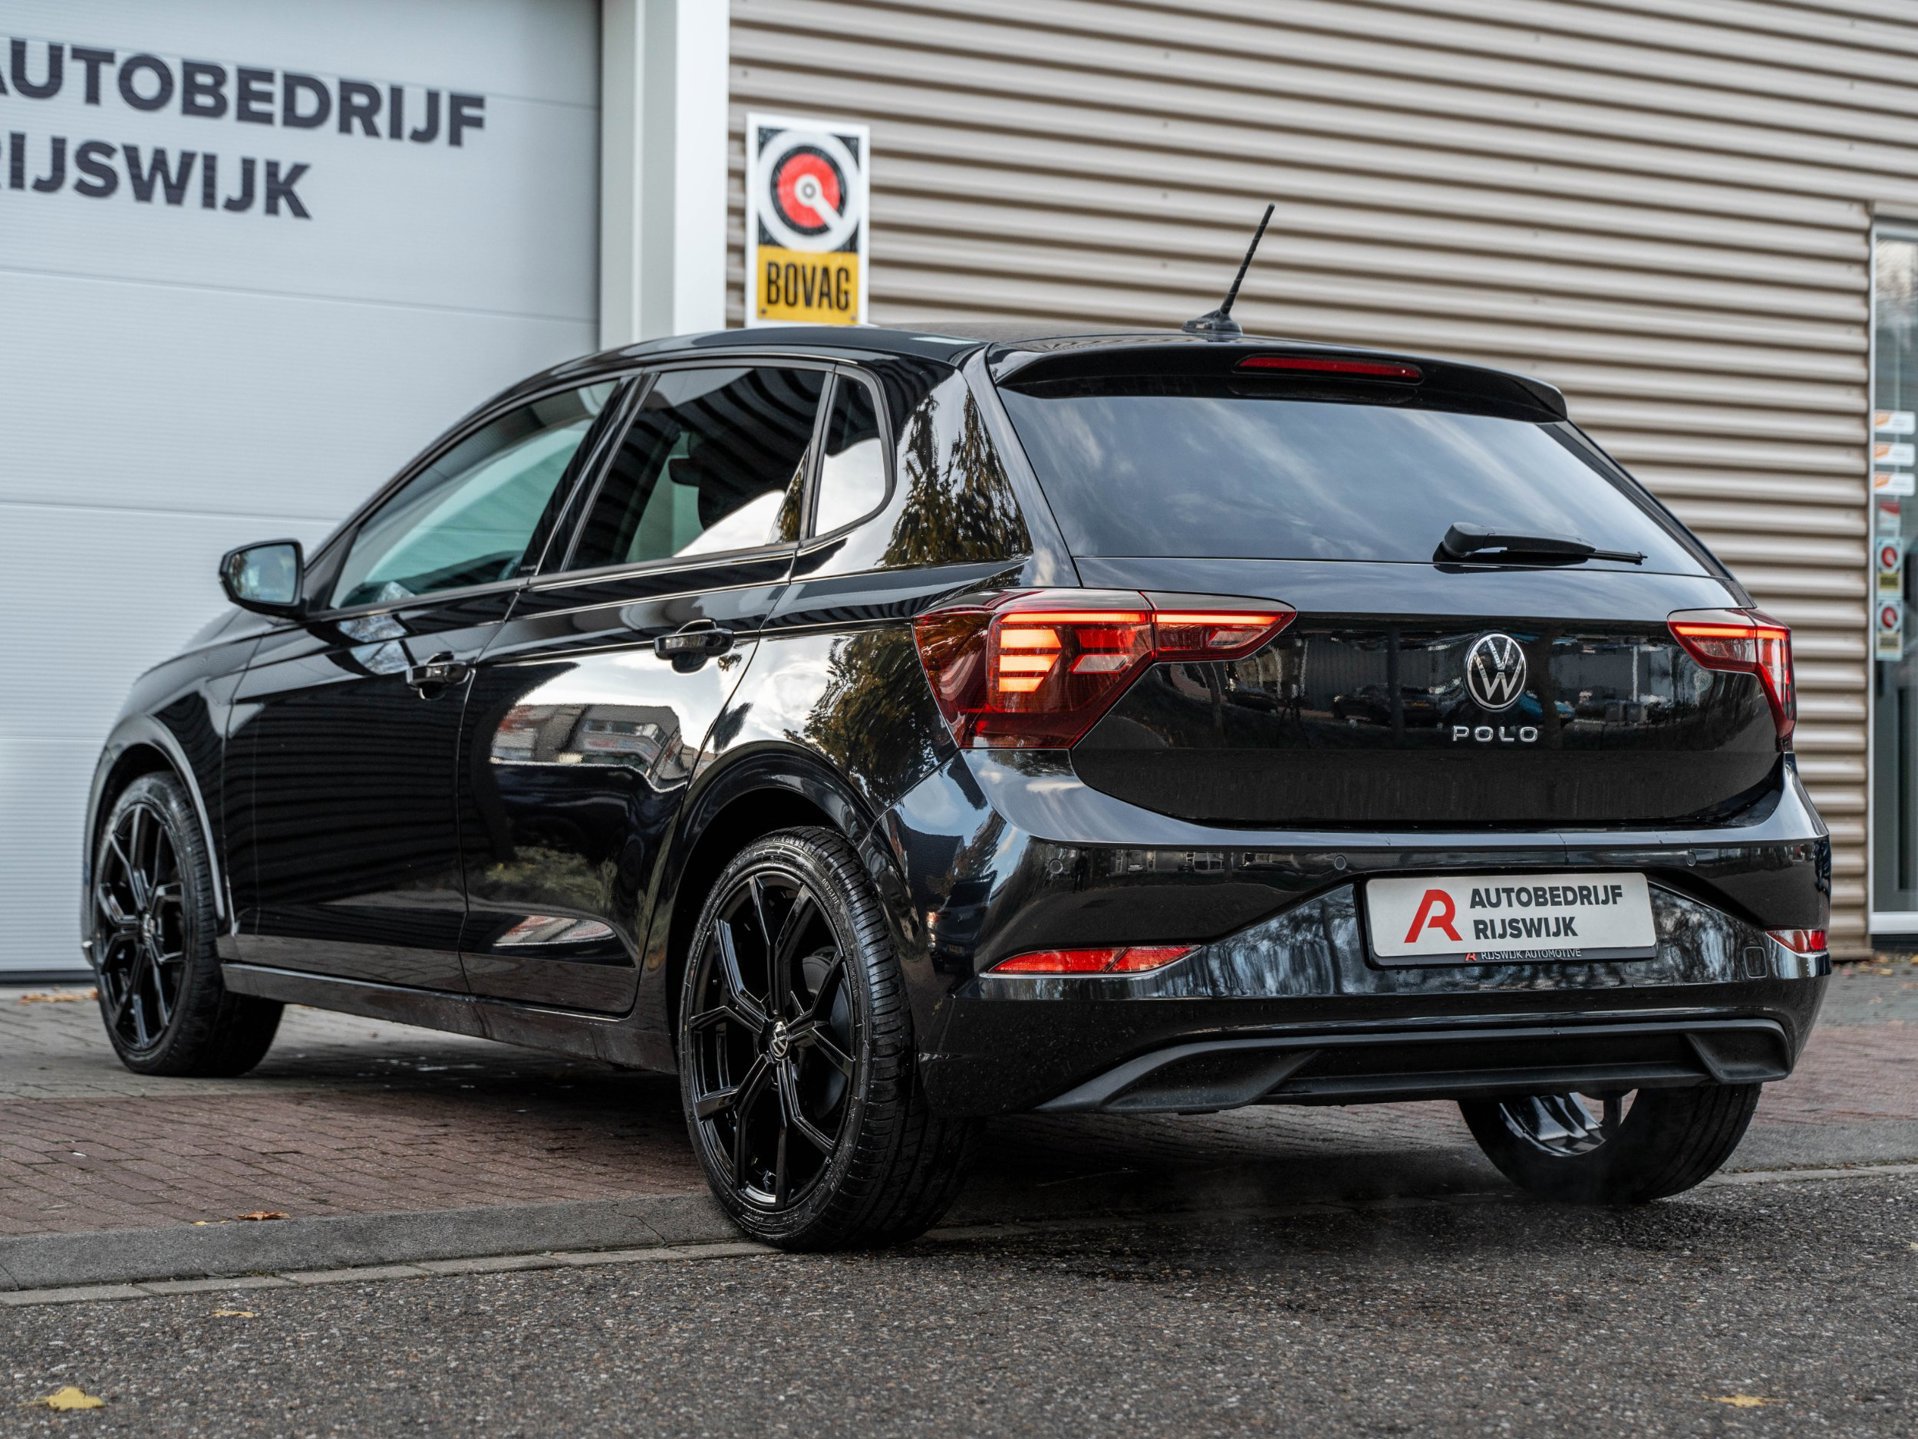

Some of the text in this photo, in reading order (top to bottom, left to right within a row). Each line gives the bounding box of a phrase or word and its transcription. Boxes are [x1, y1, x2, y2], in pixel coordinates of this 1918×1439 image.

[0, 37, 486, 147] UTOBEDRIJF
[0, 132, 312, 219] IJSWIJK
[766, 260, 850, 311] BOVAG
[1452, 725, 1538, 742] POLO
[1470, 885, 1623, 909] AUTOBEDRIJF
[1473, 916, 1579, 940] RIJSWIJK
[1481, 950, 1522, 960] RIJSWIJK
[1525, 949, 1582, 959] AUTOMOTIVE
